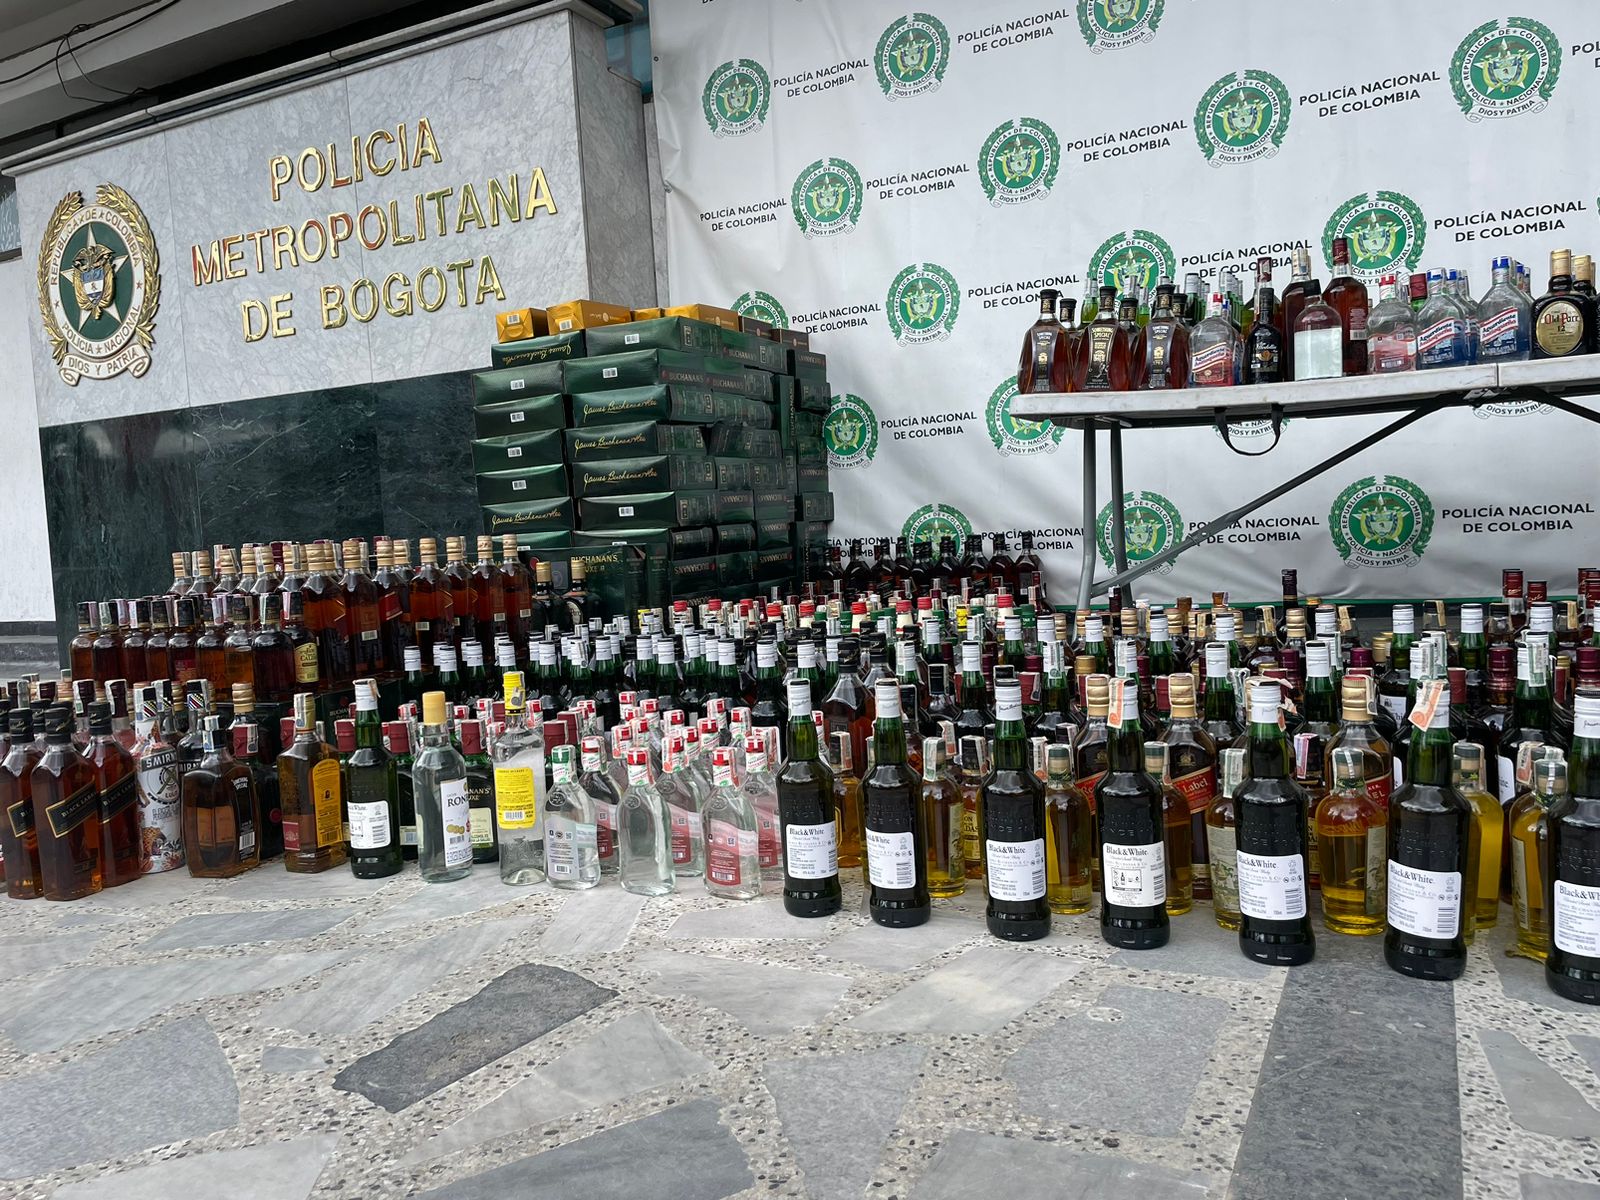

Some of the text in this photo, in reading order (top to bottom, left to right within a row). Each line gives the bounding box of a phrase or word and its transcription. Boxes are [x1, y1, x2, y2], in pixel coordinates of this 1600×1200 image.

[958, 9, 1069, 43] POLICÍA NACIONAL
[973, 27, 1053, 53] DE COLOMBIA
[774, 59, 869, 88] POLICÍA NACIONAL
[788, 74, 854, 97] DE COLOMBIA
[1300, 71, 1440, 106] POLICÍA NACIONAL
[1319, 90, 1420, 117] DE COLOMBIA
[1067, 120, 1187, 152] POLICÍA NACIONAL
[267, 117, 442, 201] POLICIA
[1084, 138, 1170, 162] DE COLOMBIA
[867, 164, 969, 189] POLICÍA NACIONAL
[880, 180, 955, 199] DE COLOMBIA
[700, 198, 787, 221] POLICÍA NACIONAL
[1435, 201, 1586, 229] POLICÍA NACIONAL
[191, 167, 558, 286] METROPOLITANA
[712, 213, 776, 231] DE COLOMBIA
[1456, 219, 1565, 242] DE COLOMBIA
[86, 208, 97, 220] DE
[105, 211, 141, 267] COLOMBIA
[1182, 249, 1224, 266] POLICÍA
[1200, 267, 1217, 278] DE
[968, 275, 1079, 298] POLICÍA NACIONAL
[240, 255, 506, 343] DE BOGOTA
[984, 299, 998, 308] DE
[792, 304, 881, 324] POLICÍA NACIONAL
[62, 304, 140, 354] POLICIA NACIONAL
[805, 318, 868, 334] DE COLOMBIA
[69, 350, 139, 375] DIOS Y PATRIA
[881, 412, 977, 429] POLICÍA NACIONAL
[894, 426, 964, 440] DE COLOMBIA
[1246, 516, 1319, 528] NACIONAL
[1442, 503, 1594, 519] POLICÍA NACIONAL
[1207, 532, 1301, 544] DE COLOMBIA
[1463, 520, 1573, 533] DE COLOMBIA
[145, 751, 177, 768] SMIRN
[1183, 778, 1209, 793] Label
